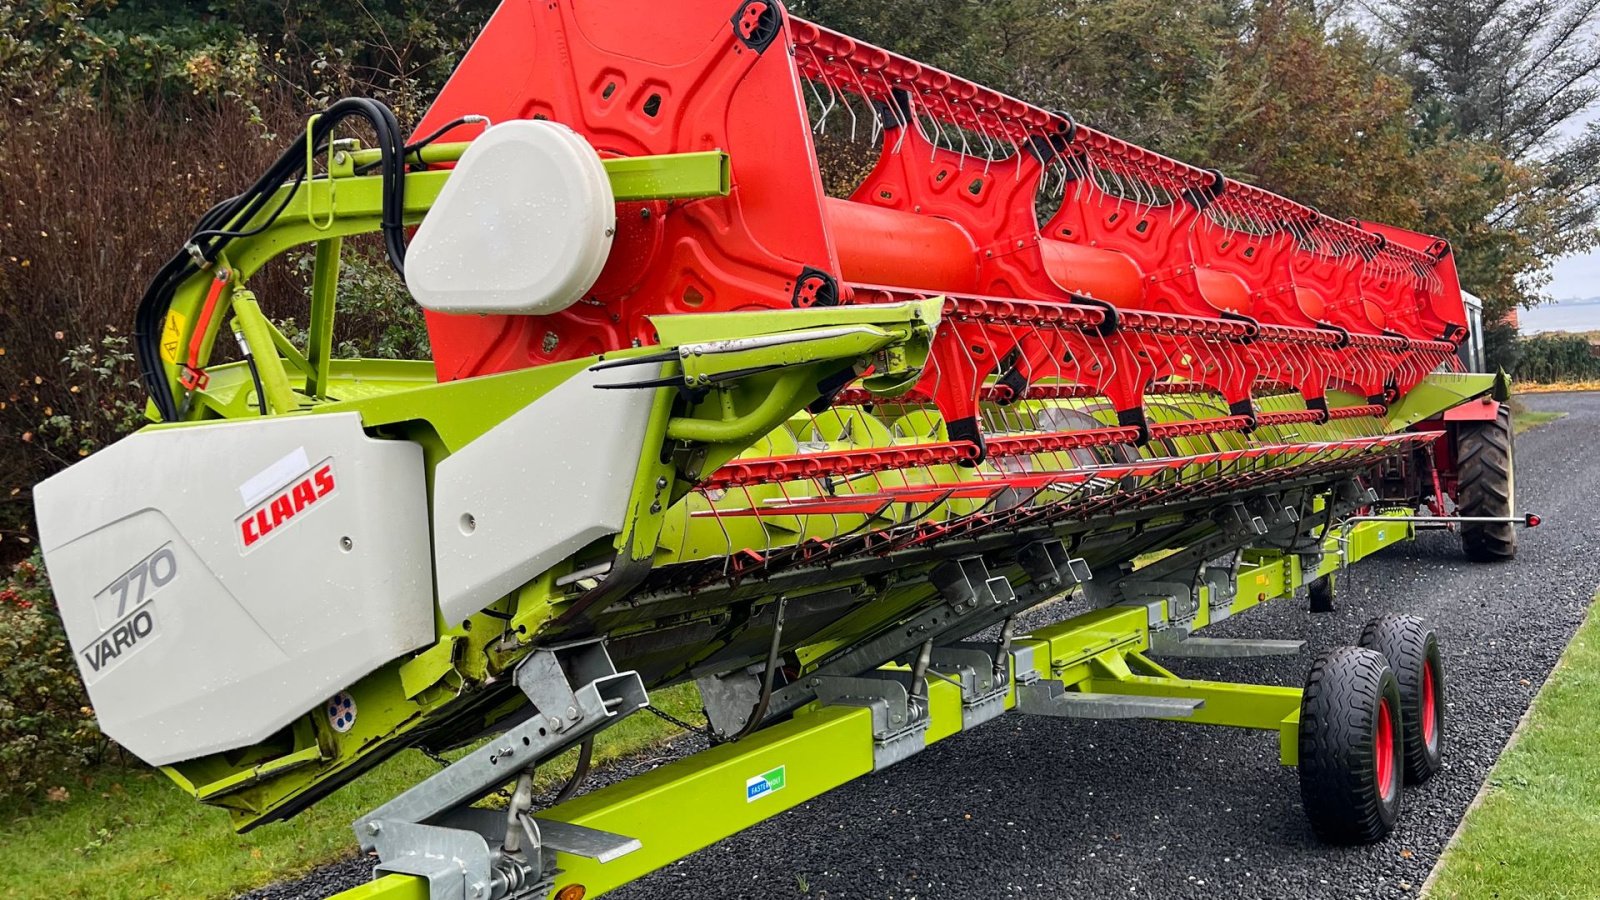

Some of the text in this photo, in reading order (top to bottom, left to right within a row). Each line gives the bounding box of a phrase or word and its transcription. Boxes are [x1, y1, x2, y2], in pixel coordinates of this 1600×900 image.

[241, 465, 335, 546] CLAAS
[110, 548, 177, 619] 770
[85, 610, 153, 672] VARIO
